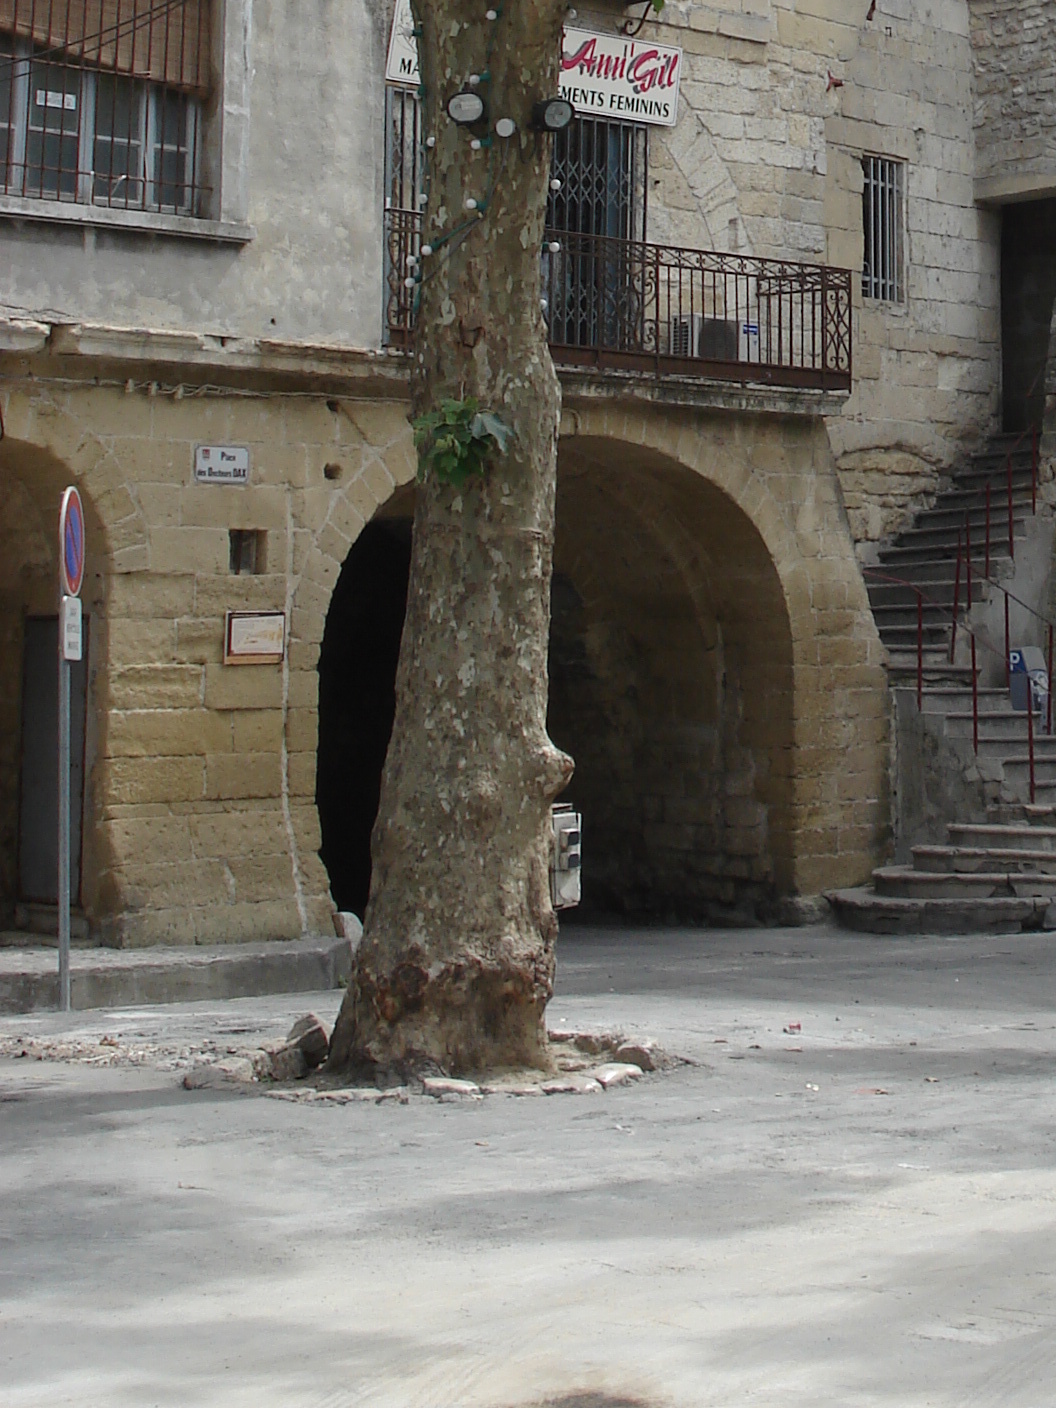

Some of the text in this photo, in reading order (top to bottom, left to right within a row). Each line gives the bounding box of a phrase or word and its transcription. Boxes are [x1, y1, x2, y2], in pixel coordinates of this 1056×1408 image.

[558, 85, 604, 107] EMENTS
[609, 94, 670, 118] FEMININS
[1010, 652, 1020, 671] P
